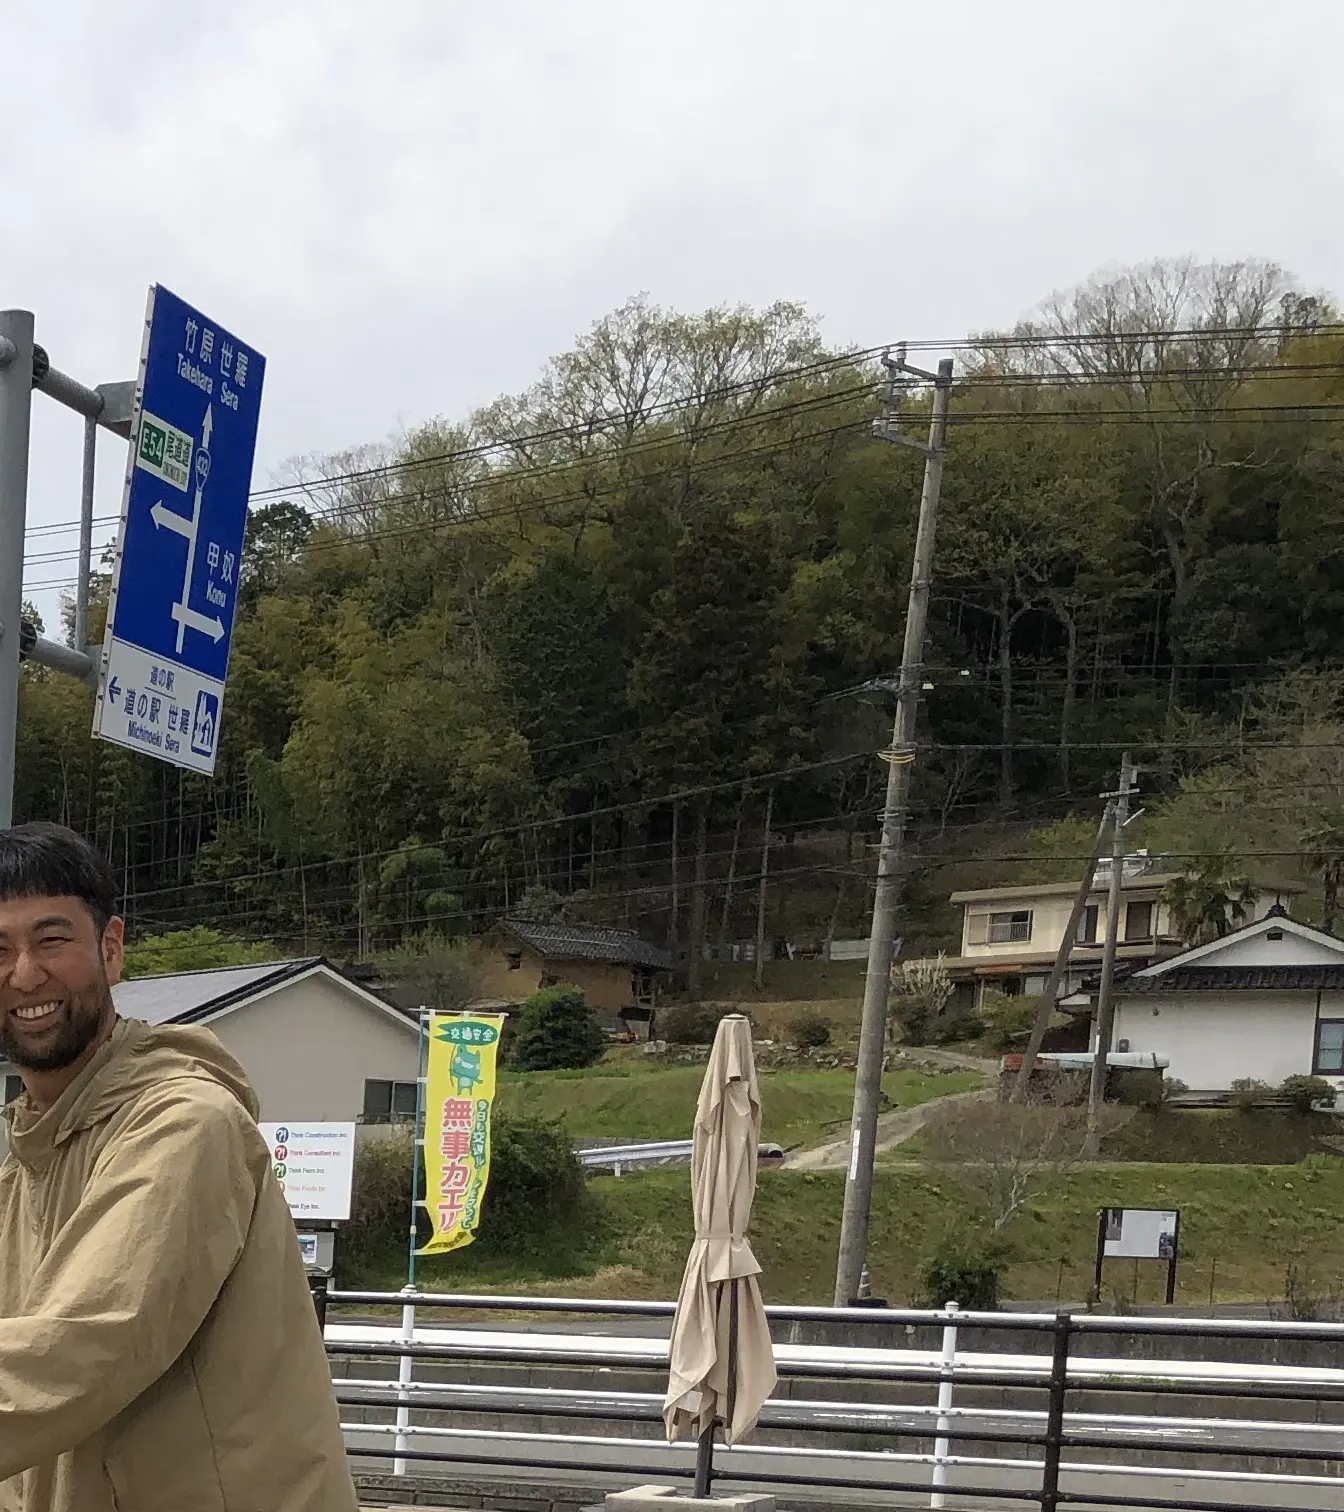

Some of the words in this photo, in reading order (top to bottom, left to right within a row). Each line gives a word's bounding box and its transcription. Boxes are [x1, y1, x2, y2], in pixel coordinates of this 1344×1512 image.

[185, 316, 214, 364] 竹原
[220, 340, 249, 389] 世羅
[177, 352, 213, 395] Takehara
[220, 381, 239, 411] Sera
[141, 427, 164, 461] E54
[206, 541, 235, 586] 甲奴
[150, 665, 175, 692] 道の駅
[124, 687, 162, 725] 道の駅
[167, 703, 191, 736] 世羅
[127, 720, 163, 748] Michinoeki
[165, 733, 180, 754] Sera
[450, 1027, 494, 1042] 交通安全
[439, 1099, 472, 1232] 無事カエル
